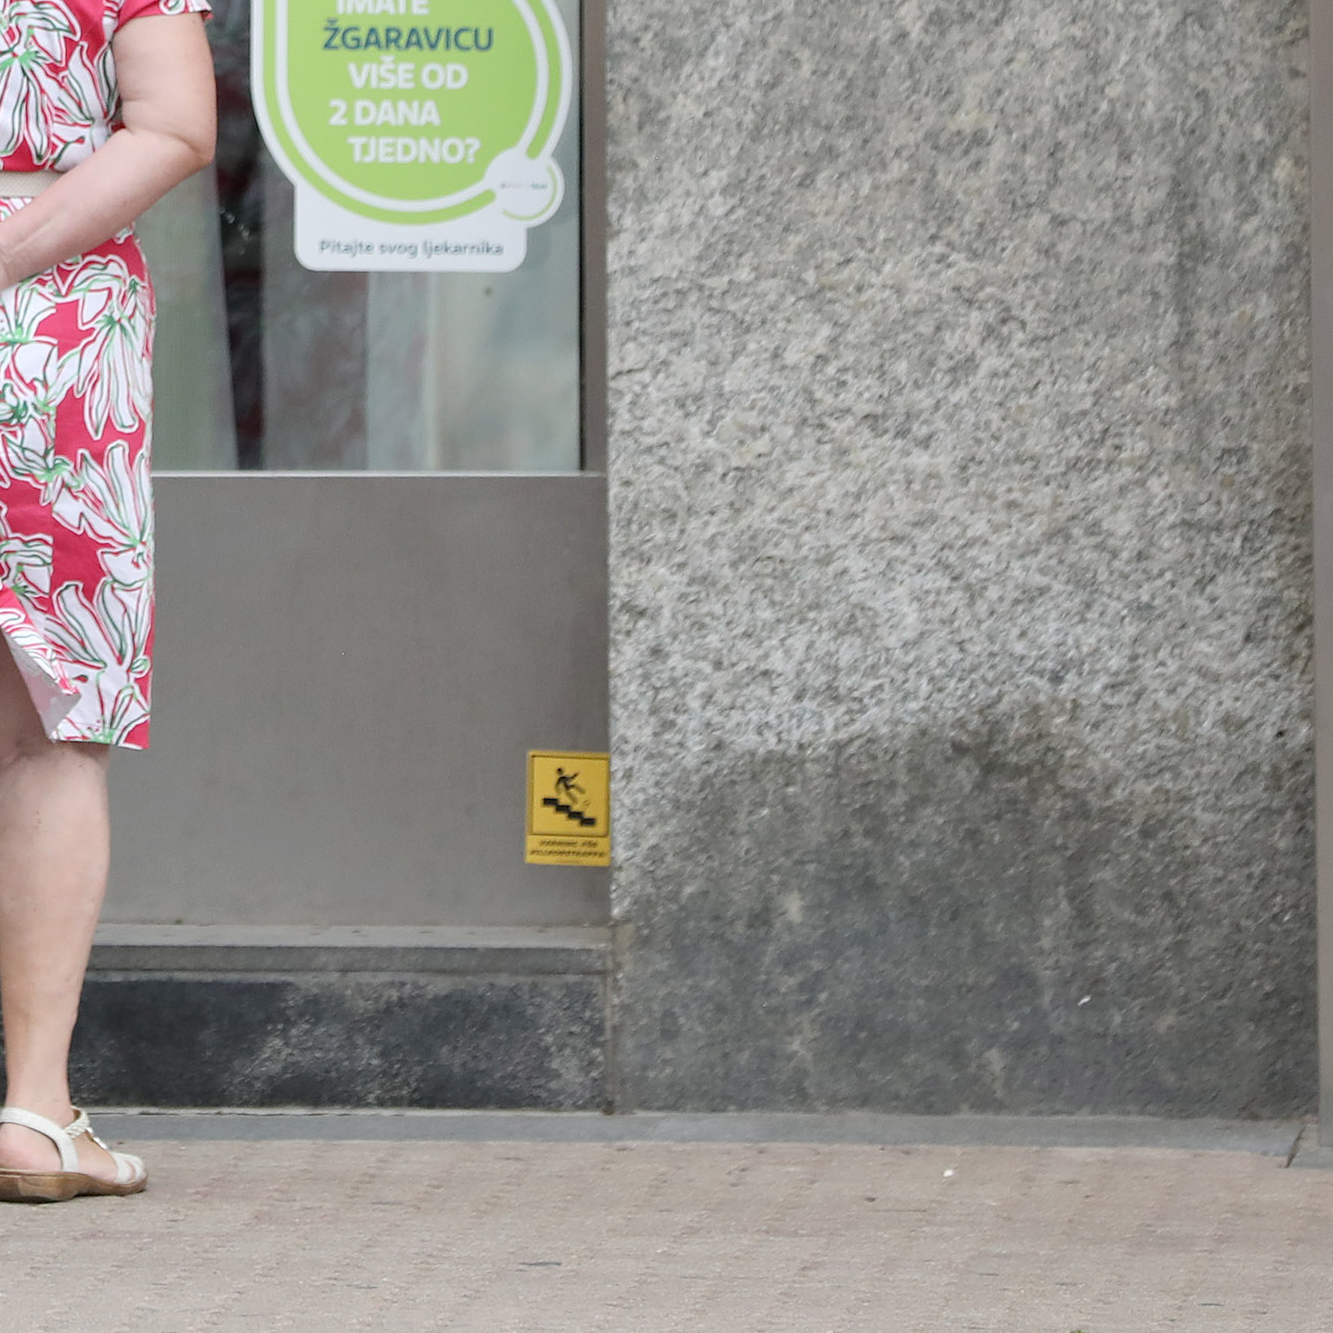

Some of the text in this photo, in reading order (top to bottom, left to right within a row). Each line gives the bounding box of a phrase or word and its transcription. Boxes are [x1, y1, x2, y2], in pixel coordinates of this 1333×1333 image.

[322, 19, 494, 52] ŽGARAVICU
[348, 55, 469, 90] VIŠE OD
[329, 100, 441, 126] 2 DANA
[347, 137, 481, 164] TJEDNO?
